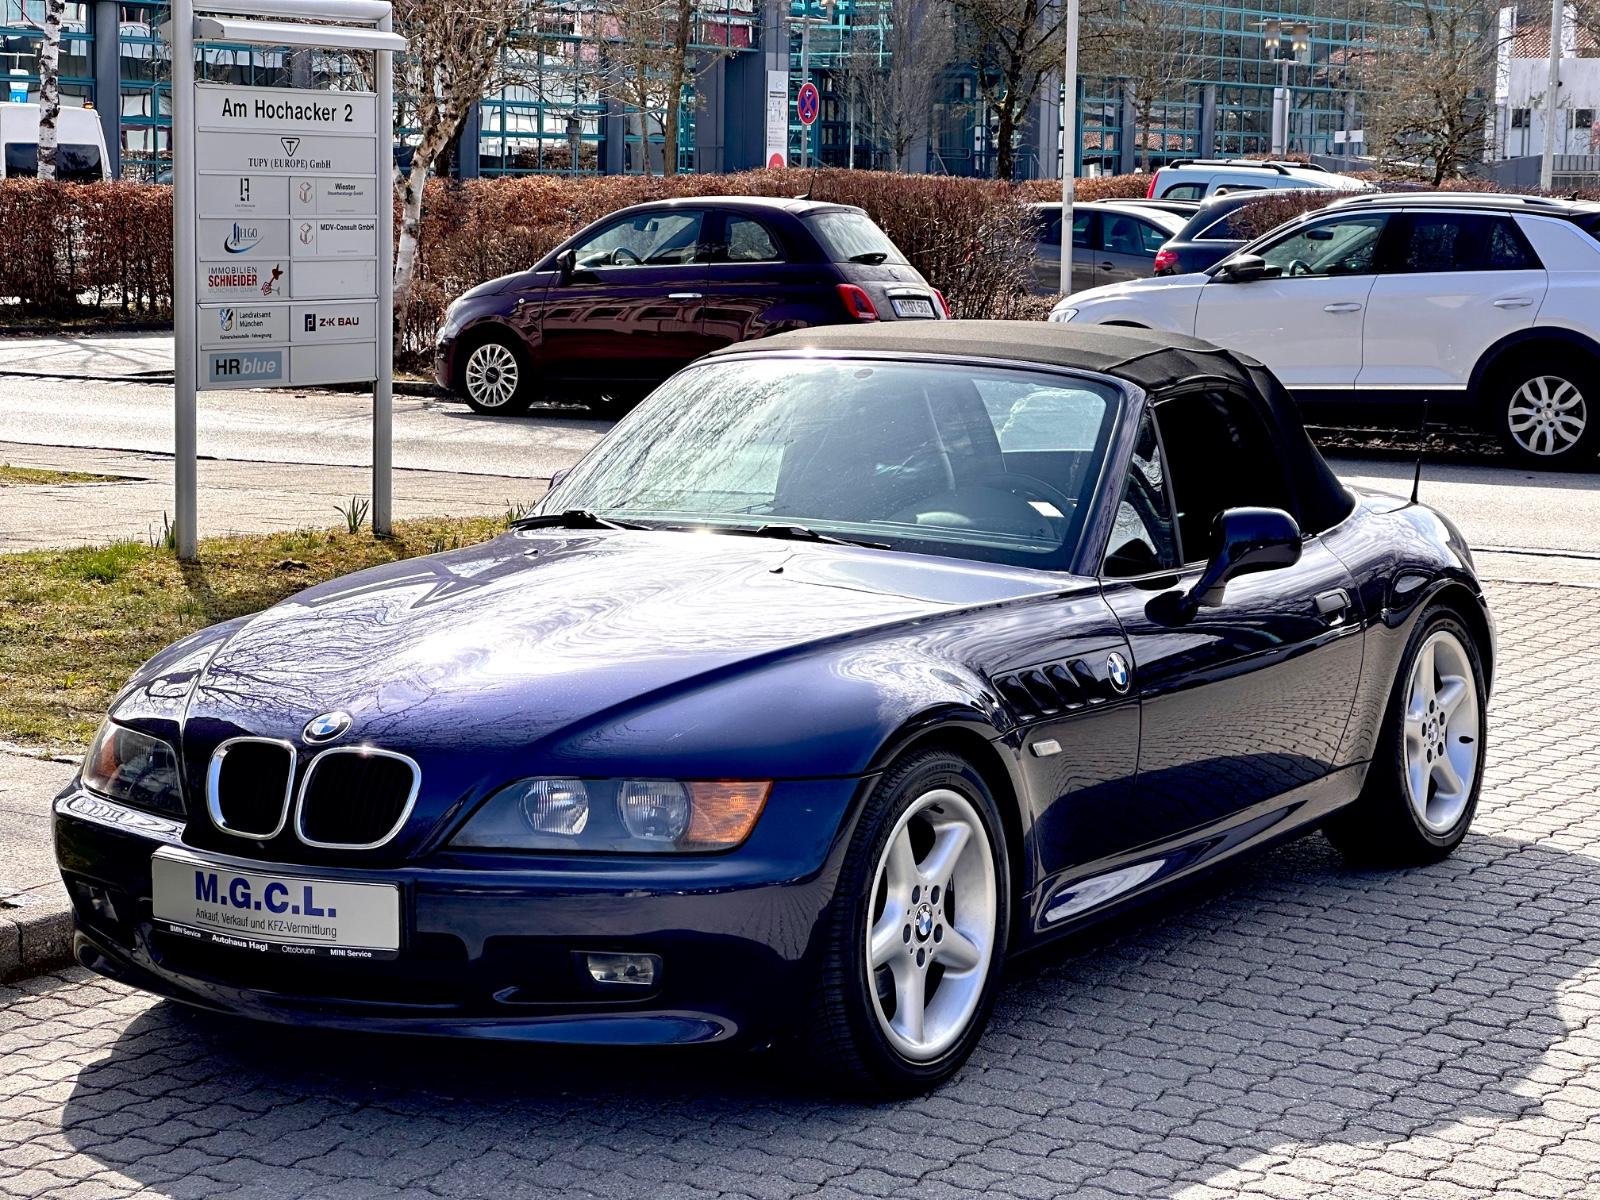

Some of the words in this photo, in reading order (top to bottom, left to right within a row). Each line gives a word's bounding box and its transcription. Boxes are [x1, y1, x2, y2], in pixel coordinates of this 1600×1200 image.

[222, 98, 247, 118] Am
[255, 99, 337, 121] Hochacker
[344, 104, 353, 122] 2
[248, 158, 269, 168] TUPY
[270, 158, 308, 169] (EUROPE)
[310, 159, 331, 169] GmbH
[208, 266, 257, 275] IMMOBILIEN
[208, 274, 258, 287] SCHNEIDER
[239, 311, 271, 319] Landratsamt
[239, 320, 264, 328] München
[319, 318, 335, 327] Z+K
[338, 317, 359, 326] BAU
[215, 358, 277, 376] HRblue
[195, 870, 337, 918] M.G.C.L.
[195, 908, 219, 923] Ankauf,
[221, 912, 248, 928] Verkauf
[250, 918, 265, 930] und
[267, 920, 337, 938] KFZ-Vermittlung
[183, 928, 201, 938] Service
[212, 934, 247, 948] Autohaus
[248, 941, 268, 952] Hagl
[281, 945, 316, 955] Ottobrunn
[330, 948, 346, 957] MINI
[347, 949, 372, 958] Service
